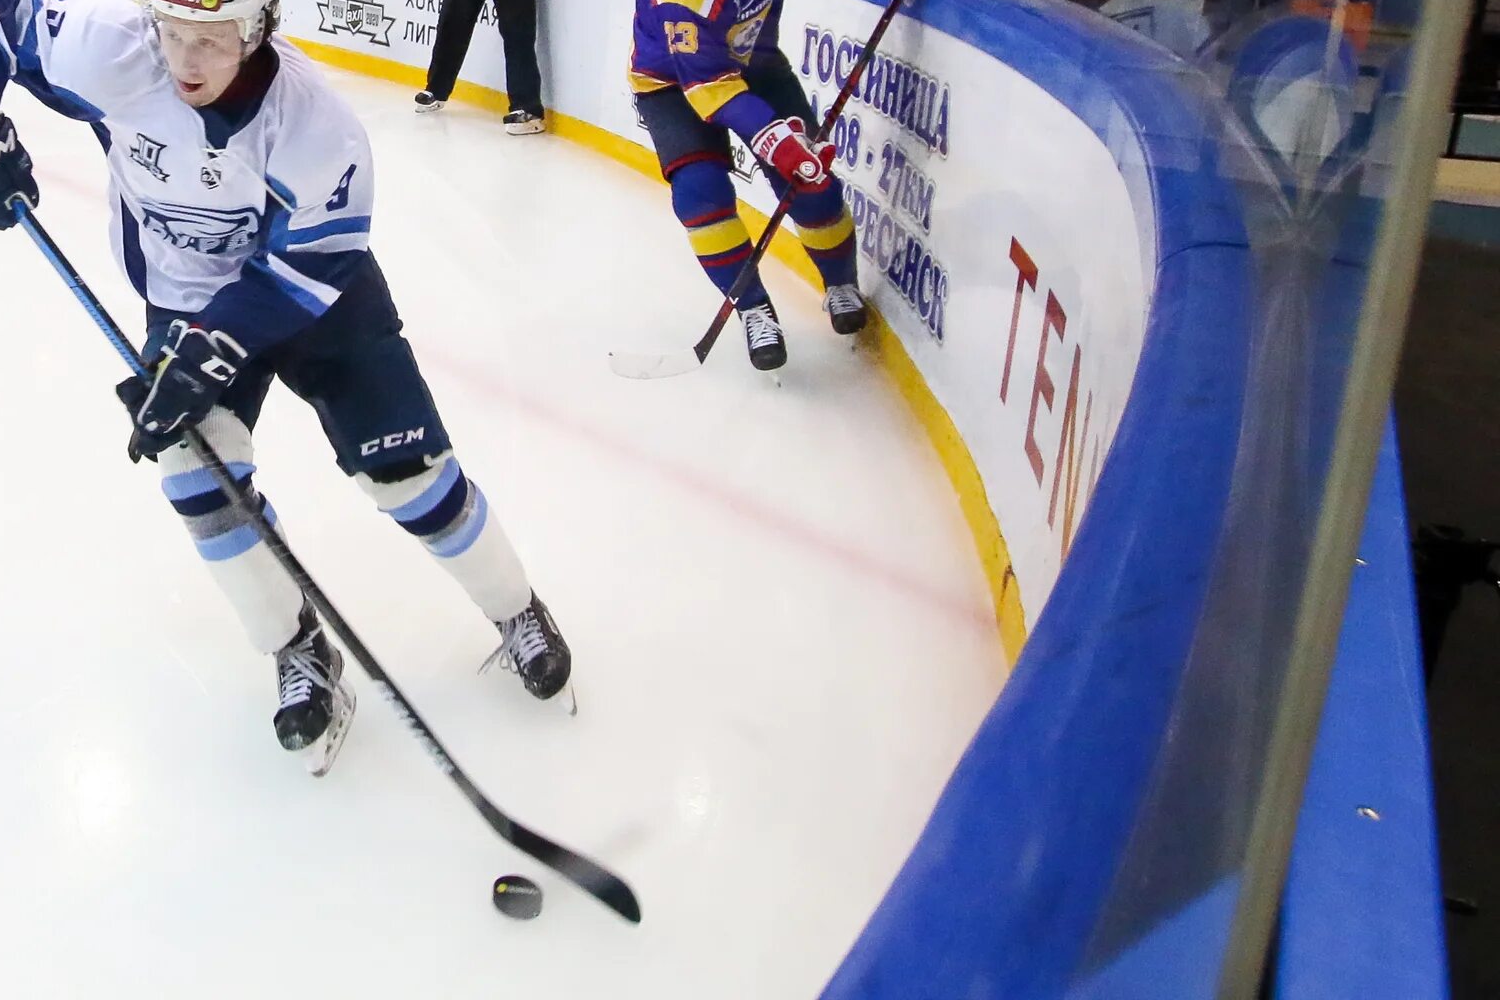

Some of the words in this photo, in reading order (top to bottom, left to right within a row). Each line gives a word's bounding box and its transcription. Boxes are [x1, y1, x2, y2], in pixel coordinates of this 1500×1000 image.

[347, 9, 363, 23] ВХЛ
[403, 21, 438, 46] ЛИГ
[325, 163, 358, 213] 9
[360, 426, 425, 457] CCM
